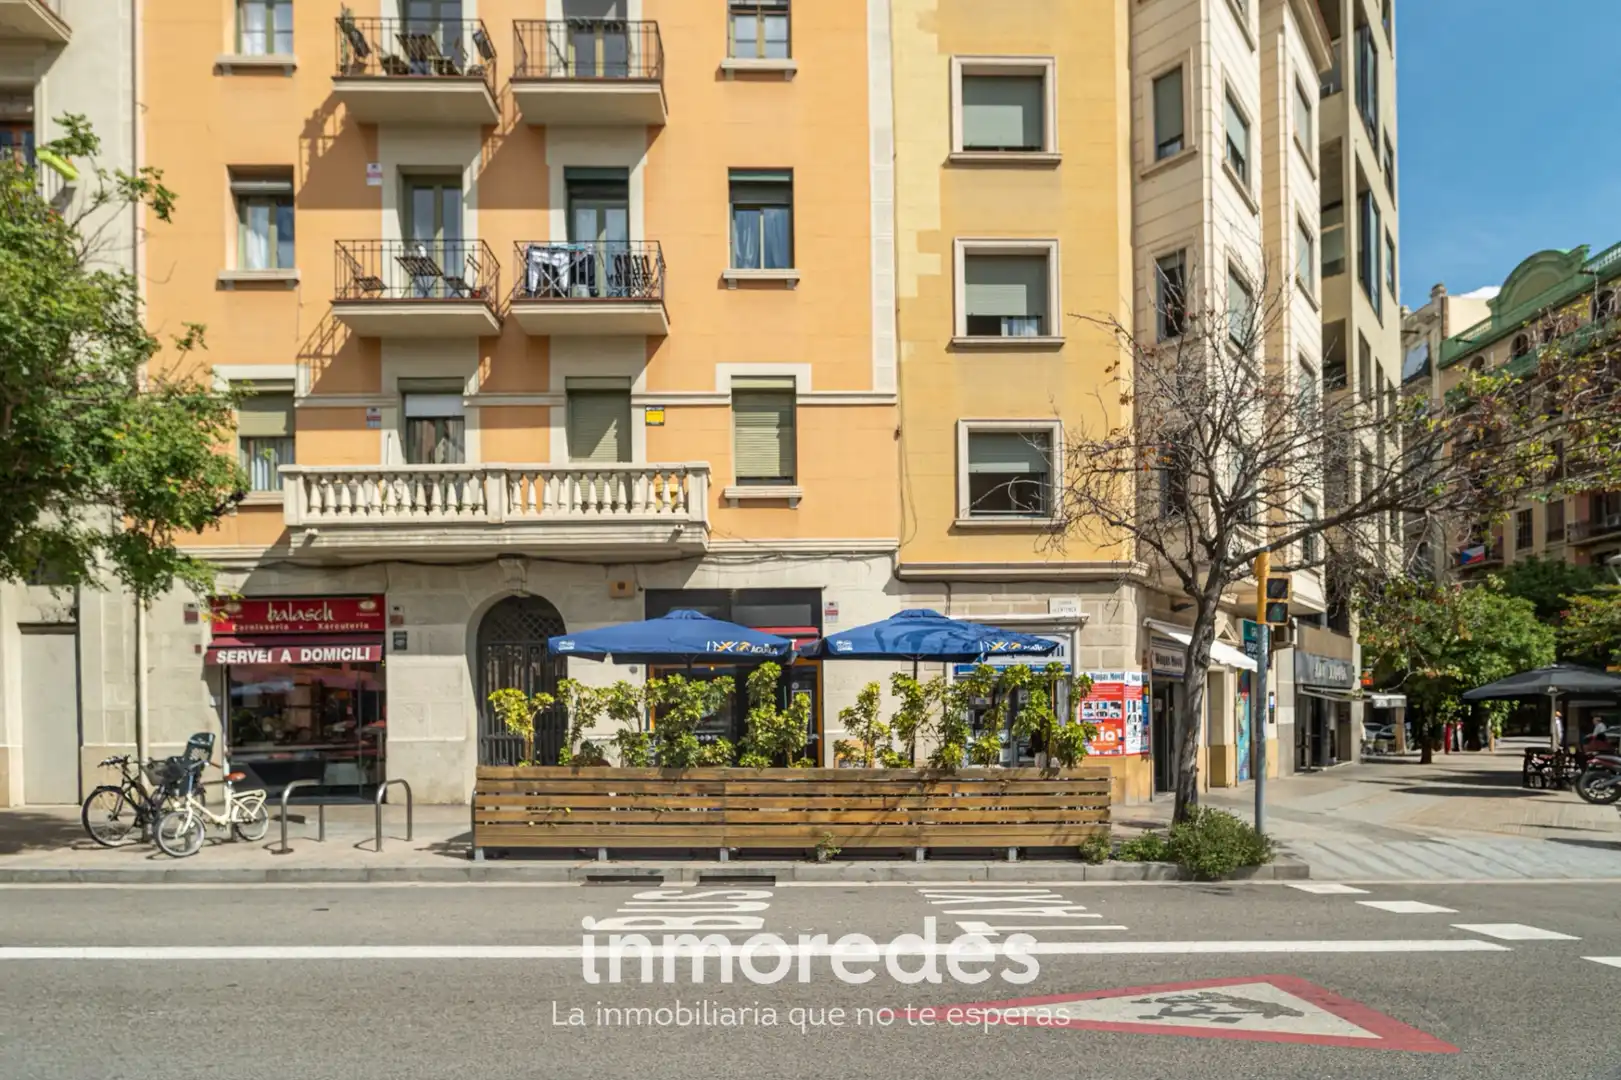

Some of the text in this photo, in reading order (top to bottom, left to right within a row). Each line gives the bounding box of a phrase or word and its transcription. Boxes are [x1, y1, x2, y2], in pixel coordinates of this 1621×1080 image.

[267, 602, 335, 622] balasch
[232, 621, 370, 632] Carnisseria Xarcuteria
[216, 646, 371, 664] SERVEI A DOMICILI
[594, 889, 773, 930] BUS
[918, 889, 1128, 936] TAXI
